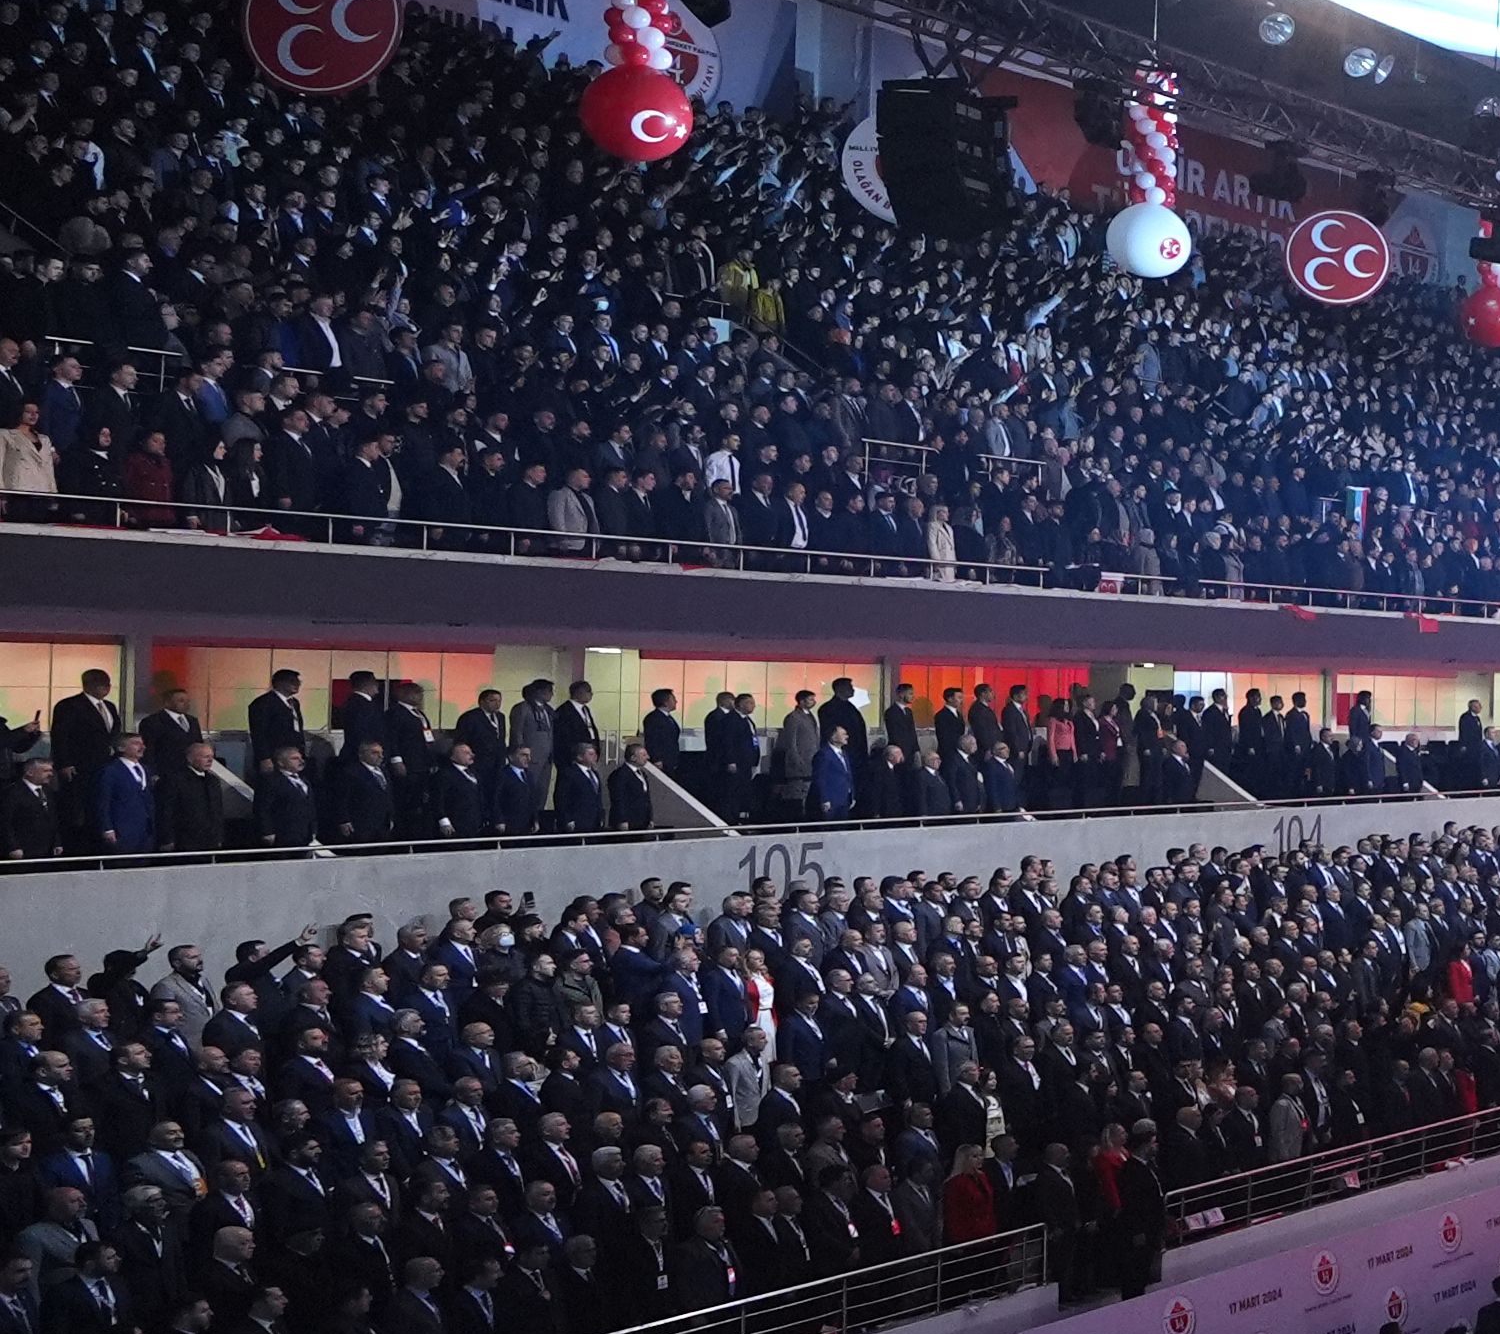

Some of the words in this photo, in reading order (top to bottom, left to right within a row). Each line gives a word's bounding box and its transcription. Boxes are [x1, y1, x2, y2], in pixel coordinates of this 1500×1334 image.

[695, 65, 715, 99] ULTAYI
[852, 159, 883, 204] OLAĞAN
[739, 842, 825, 899] 105
[1229, 1300, 1237, 1315] 17
[1239, 1294, 1260, 1313] MART
[1261, 1287, 1283, 1307] 2024
